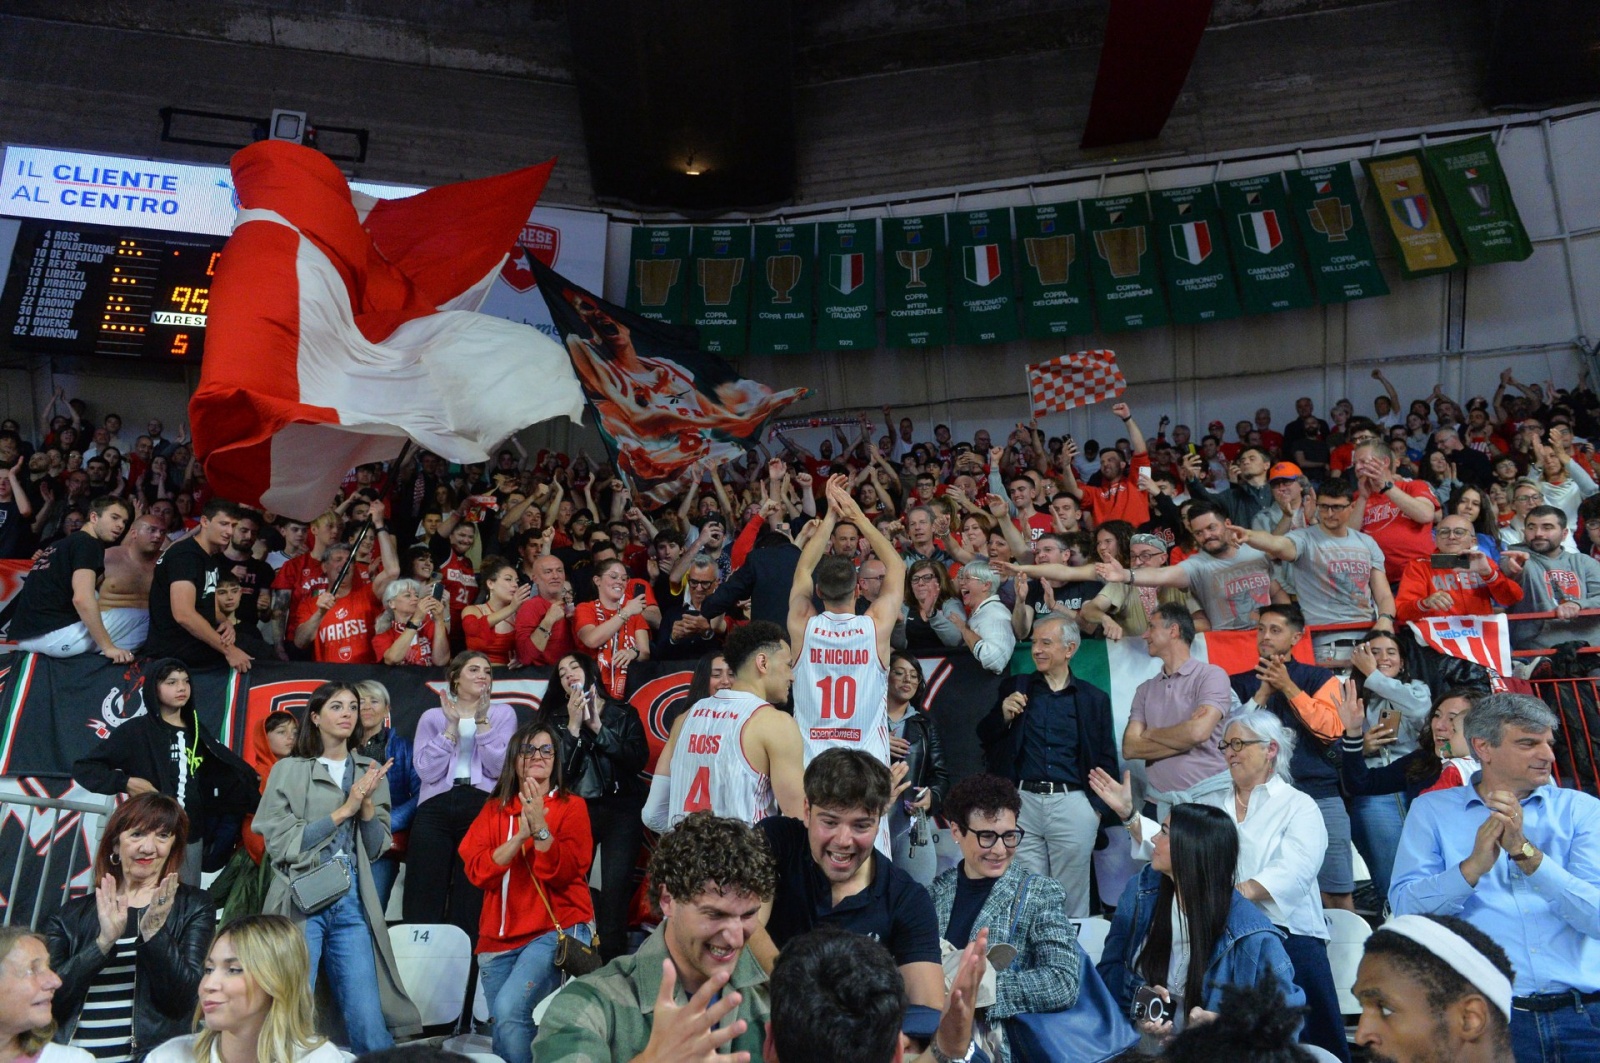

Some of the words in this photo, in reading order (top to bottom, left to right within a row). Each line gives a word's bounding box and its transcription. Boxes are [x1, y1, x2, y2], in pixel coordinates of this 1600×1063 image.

[17, 160, 42, 178] IL
[53, 164, 179, 191] CLIENTE
[11, 185, 50, 203] AL
[60, 189, 180, 215] CENTRO
[45, 230, 50, 239] 4
[54, 231, 80, 241] ROSS
[518, 227, 554, 244] RESE
[42, 240, 50, 248] 8
[53, 240, 116, 255] WOLDETENSAE
[36, 248, 47, 258] 10
[50, 250, 62, 259] DE
[64, 251, 104, 264] NICOLAO
[33, 258, 45, 267] 12
[48, 259, 78, 270] REYES
[1247, 263, 1296, 276] CAMPIONATO
[1320, 265, 1346, 273] DELLE
[30, 267, 42, 277] 13
[45, 268, 86, 280] LIBRIZZI
[1176, 274, 1224, 286] CAMPIONATO
[1255, 271, 1290, 281] ITALIANO
[28, 277, 40, 286] 18
[44, 278, 87, 290] VIRGINIO
[1116, 284, 1142, 292] COPPA
[1184, 282, 1217, 292] ITALIANO
[25, 286, 37, 296] 21
[40, 288, 82, 300] FERRERO
[1044, 290, 1068, 298] COPPA
[21, 296, 34, 306] 22
[38, 298, 75, 308] BROWN
[963, 297, 1008, 306] CAMPIONATO
[18, 306, 32, 315] 30
[35, 307, 74, 319] CARUSO
[826, 305, 868, 313] CAMPIONATO
[891, 308, 944, 317] CONTINENTALE
[17, 316, 30, 326] 41
[33, 317, 70, 328] OWENS
[154, 313, 206, 326] VARES
[13, 326, 27, 336] 92
[30, 327, 78, 340] JOHNSON
[171, 334, 188, 354] 5
[1228, 576, 1270, 594] VARESE
[456, 588, 469, 604] 21
[320, 619, 368, 644] VARESE
[810, 648, 822, 664] DE
[825, 649, 869, 665] NICOLAO
[816, 675, 857, 720] 10
[688, 734, 722, 754] ROSS
[684, 766, 712, 812] 4
[413, 930, 430, 942] 14
